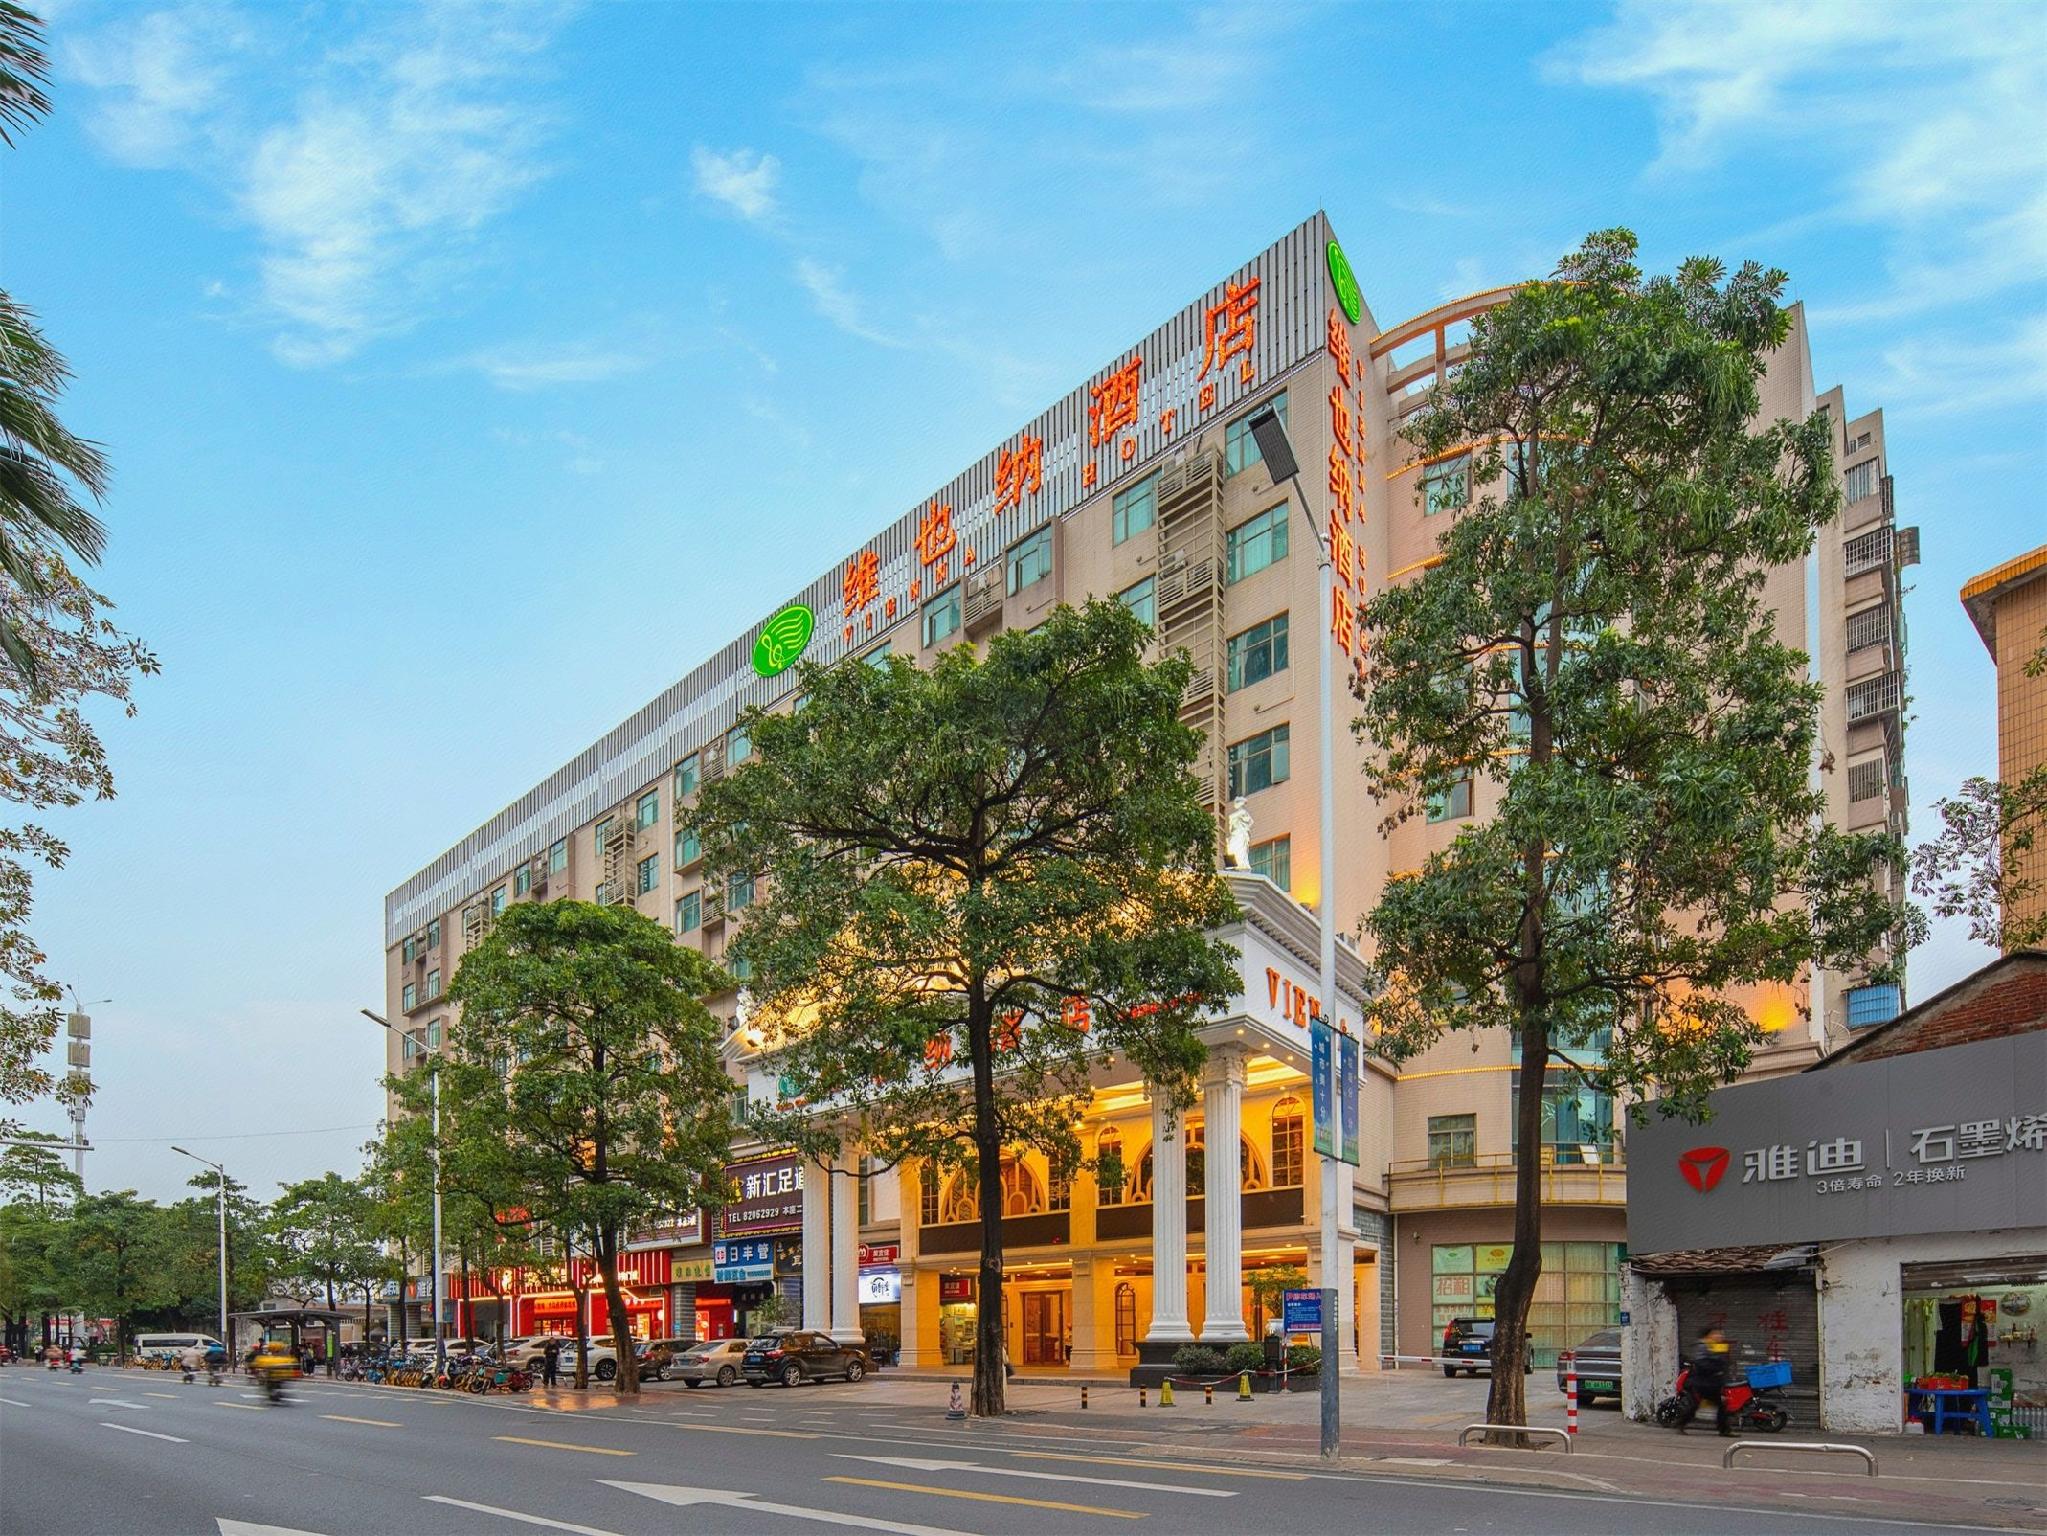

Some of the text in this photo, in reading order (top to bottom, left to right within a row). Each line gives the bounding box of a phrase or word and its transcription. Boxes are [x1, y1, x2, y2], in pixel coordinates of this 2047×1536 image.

[843, 276, 1261, 619] 维也纳酒店
[1327, 307, 1353, 658] 维也纳酒店
[1356, 358, 1366, 524] VIENNA
[843, 360, 1255, 643] VIENNA HOTEL
[1742, 1114, 2047, 1184] 雅迪 石墨烯
[1815, 1165, 1967, 1195] 3倍寿命 2年换新
[728, 1213, 741, 1224] TEL
[730, 1242, 769, 1262] 日丰管
